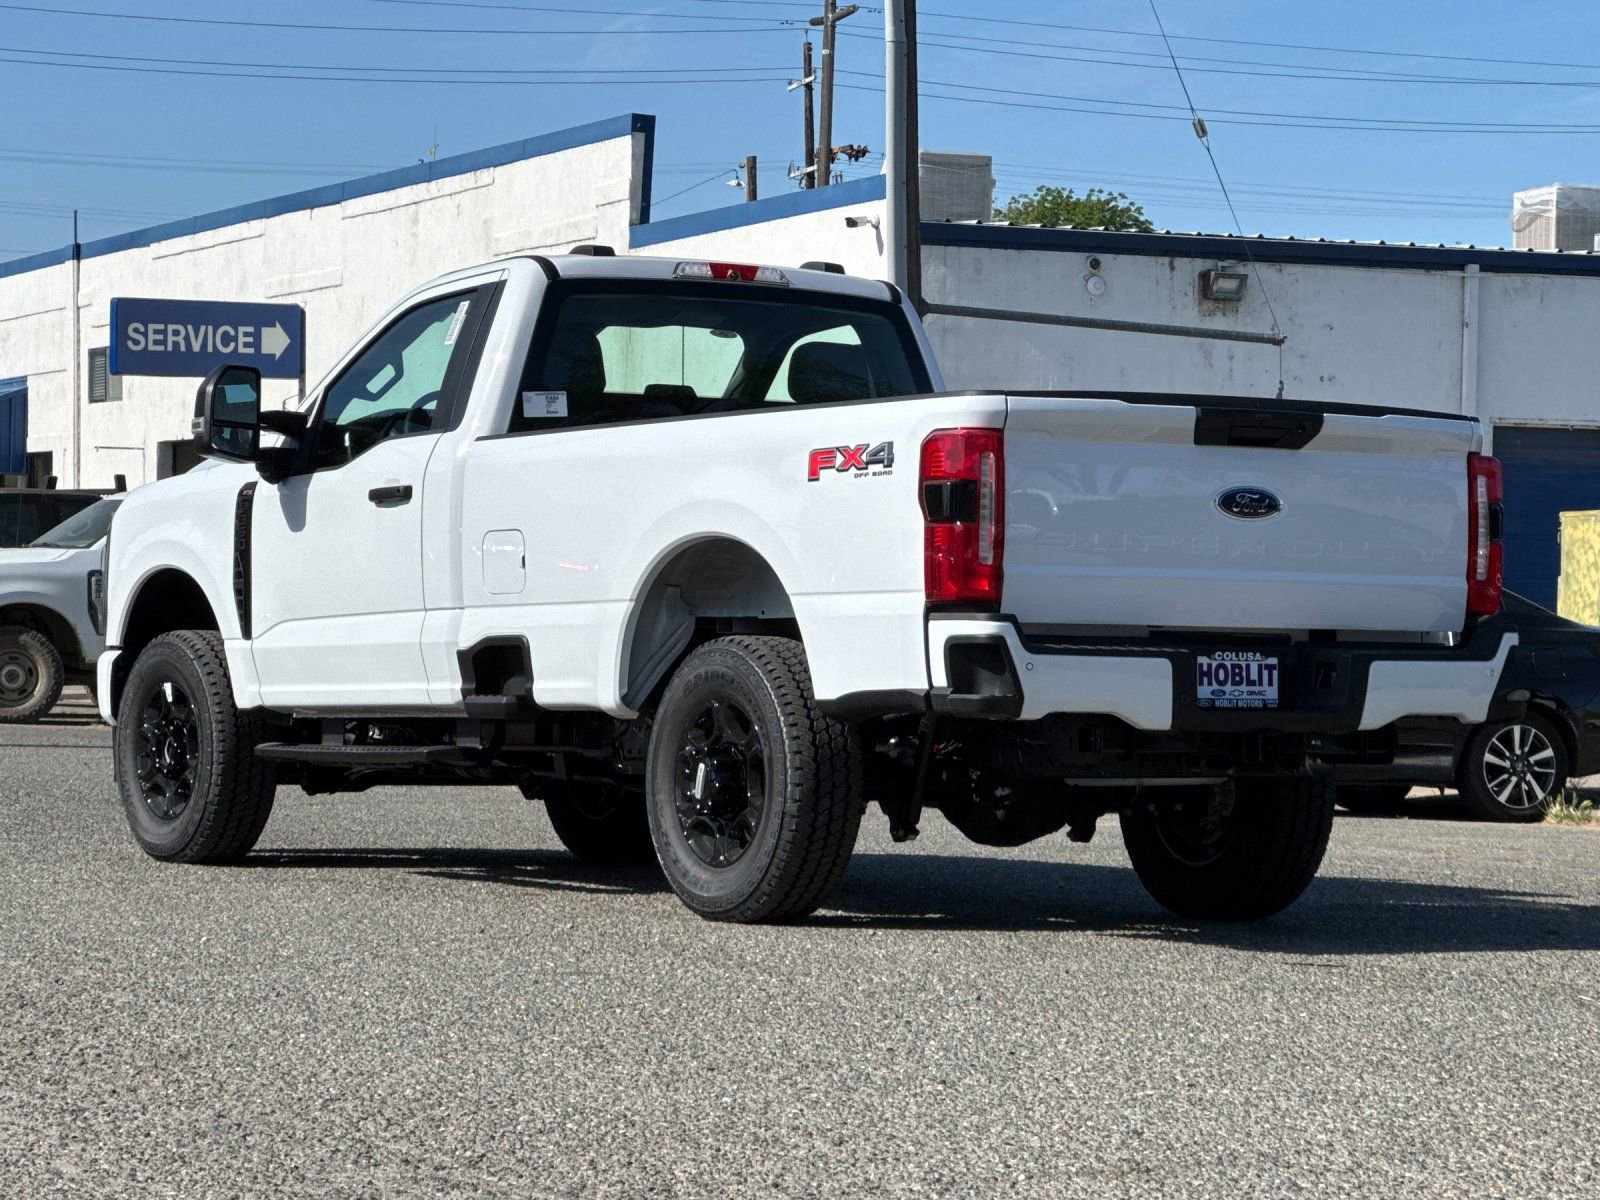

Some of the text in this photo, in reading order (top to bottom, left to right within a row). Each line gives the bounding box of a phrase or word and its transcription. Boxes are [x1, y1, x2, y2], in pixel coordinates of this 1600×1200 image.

[126, 322, 255, 354] SERVICE
[807, 440, 895, 482] FX4
[871, 470, 893, 478] ROAD
[1232, 492, 1270, 513] Ford
[1214, 651, 1263, 661] COLUSA
[1197, 662, 1278, 688] HOBLIT
[1215, 698, 1237, 708] HOBLIT
[1237, 698, 1263, 708] MOTORS
